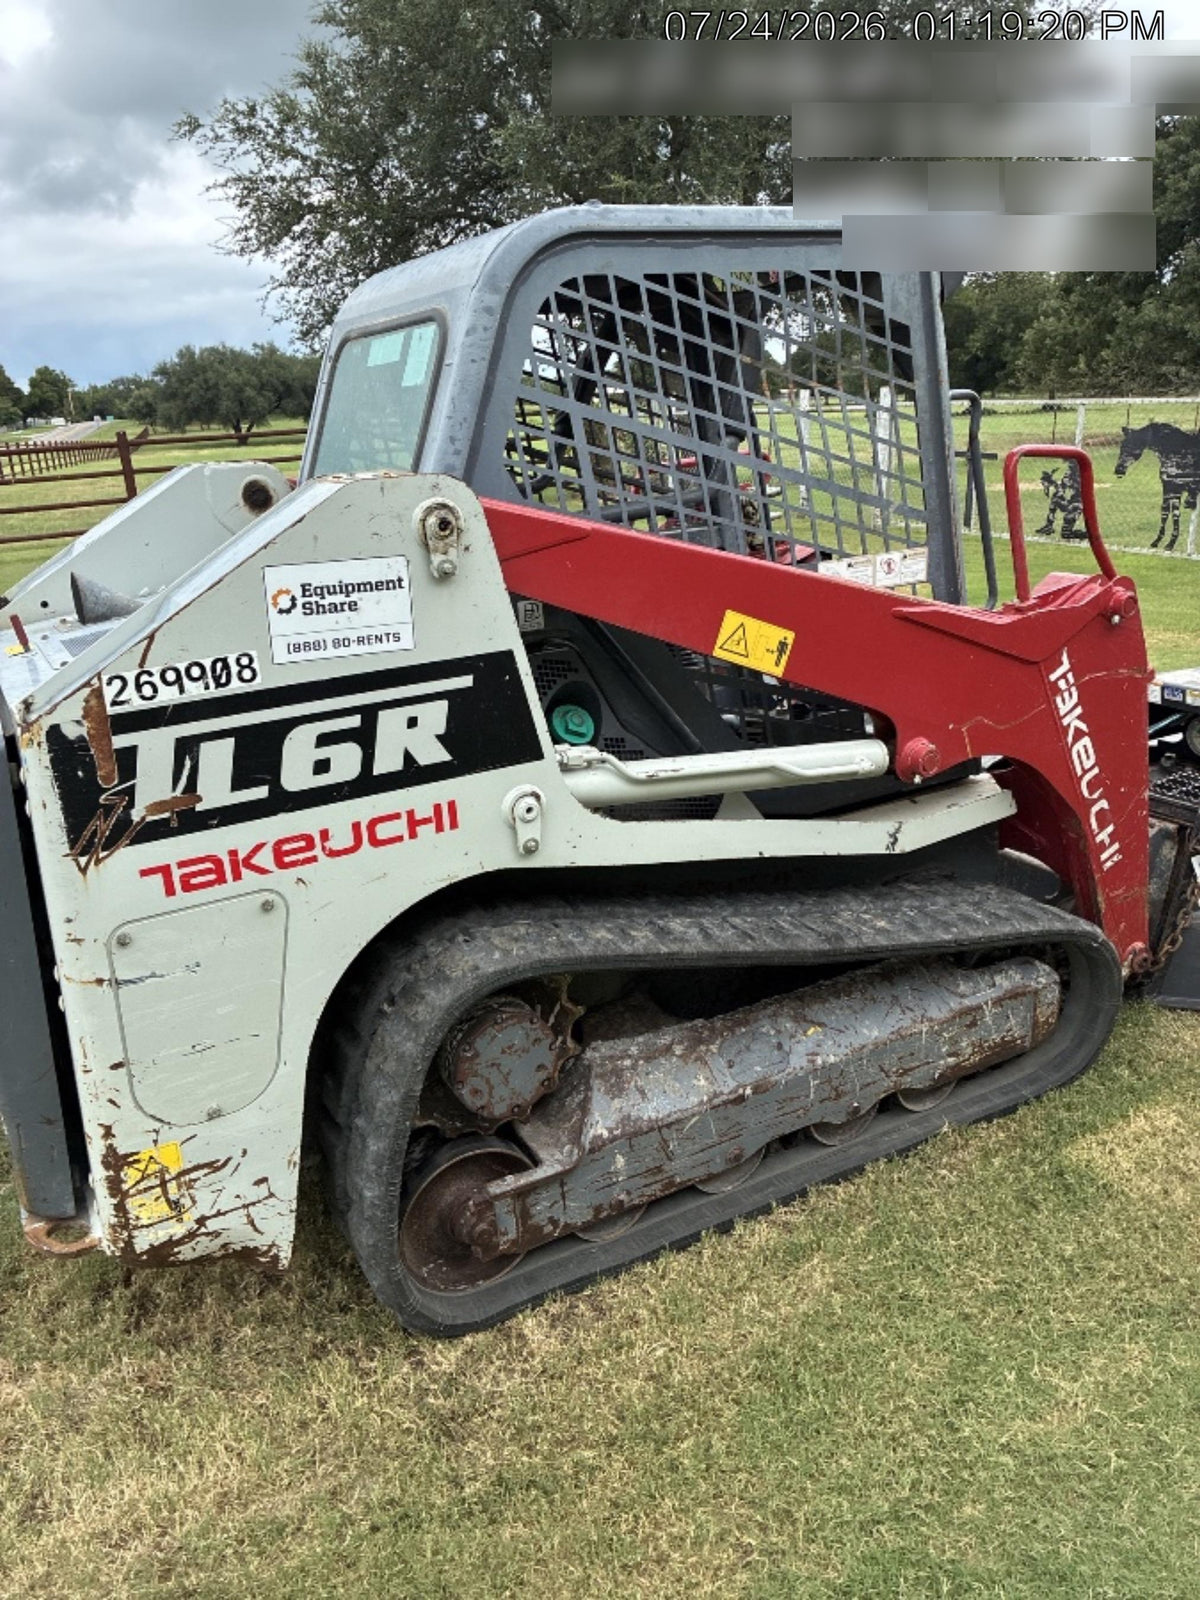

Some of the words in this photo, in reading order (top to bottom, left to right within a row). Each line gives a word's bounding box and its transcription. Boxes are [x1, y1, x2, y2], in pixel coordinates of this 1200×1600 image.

[300, 576, 405, 600] Equipment
[302, 600, 358, 616] Share
[287, 639, 327, 654] (888)
[332, 632, 401, 649] 80-RENTS
[106, 652, 258, 707] 269908
[112, 700, 455, 822] TL6R
